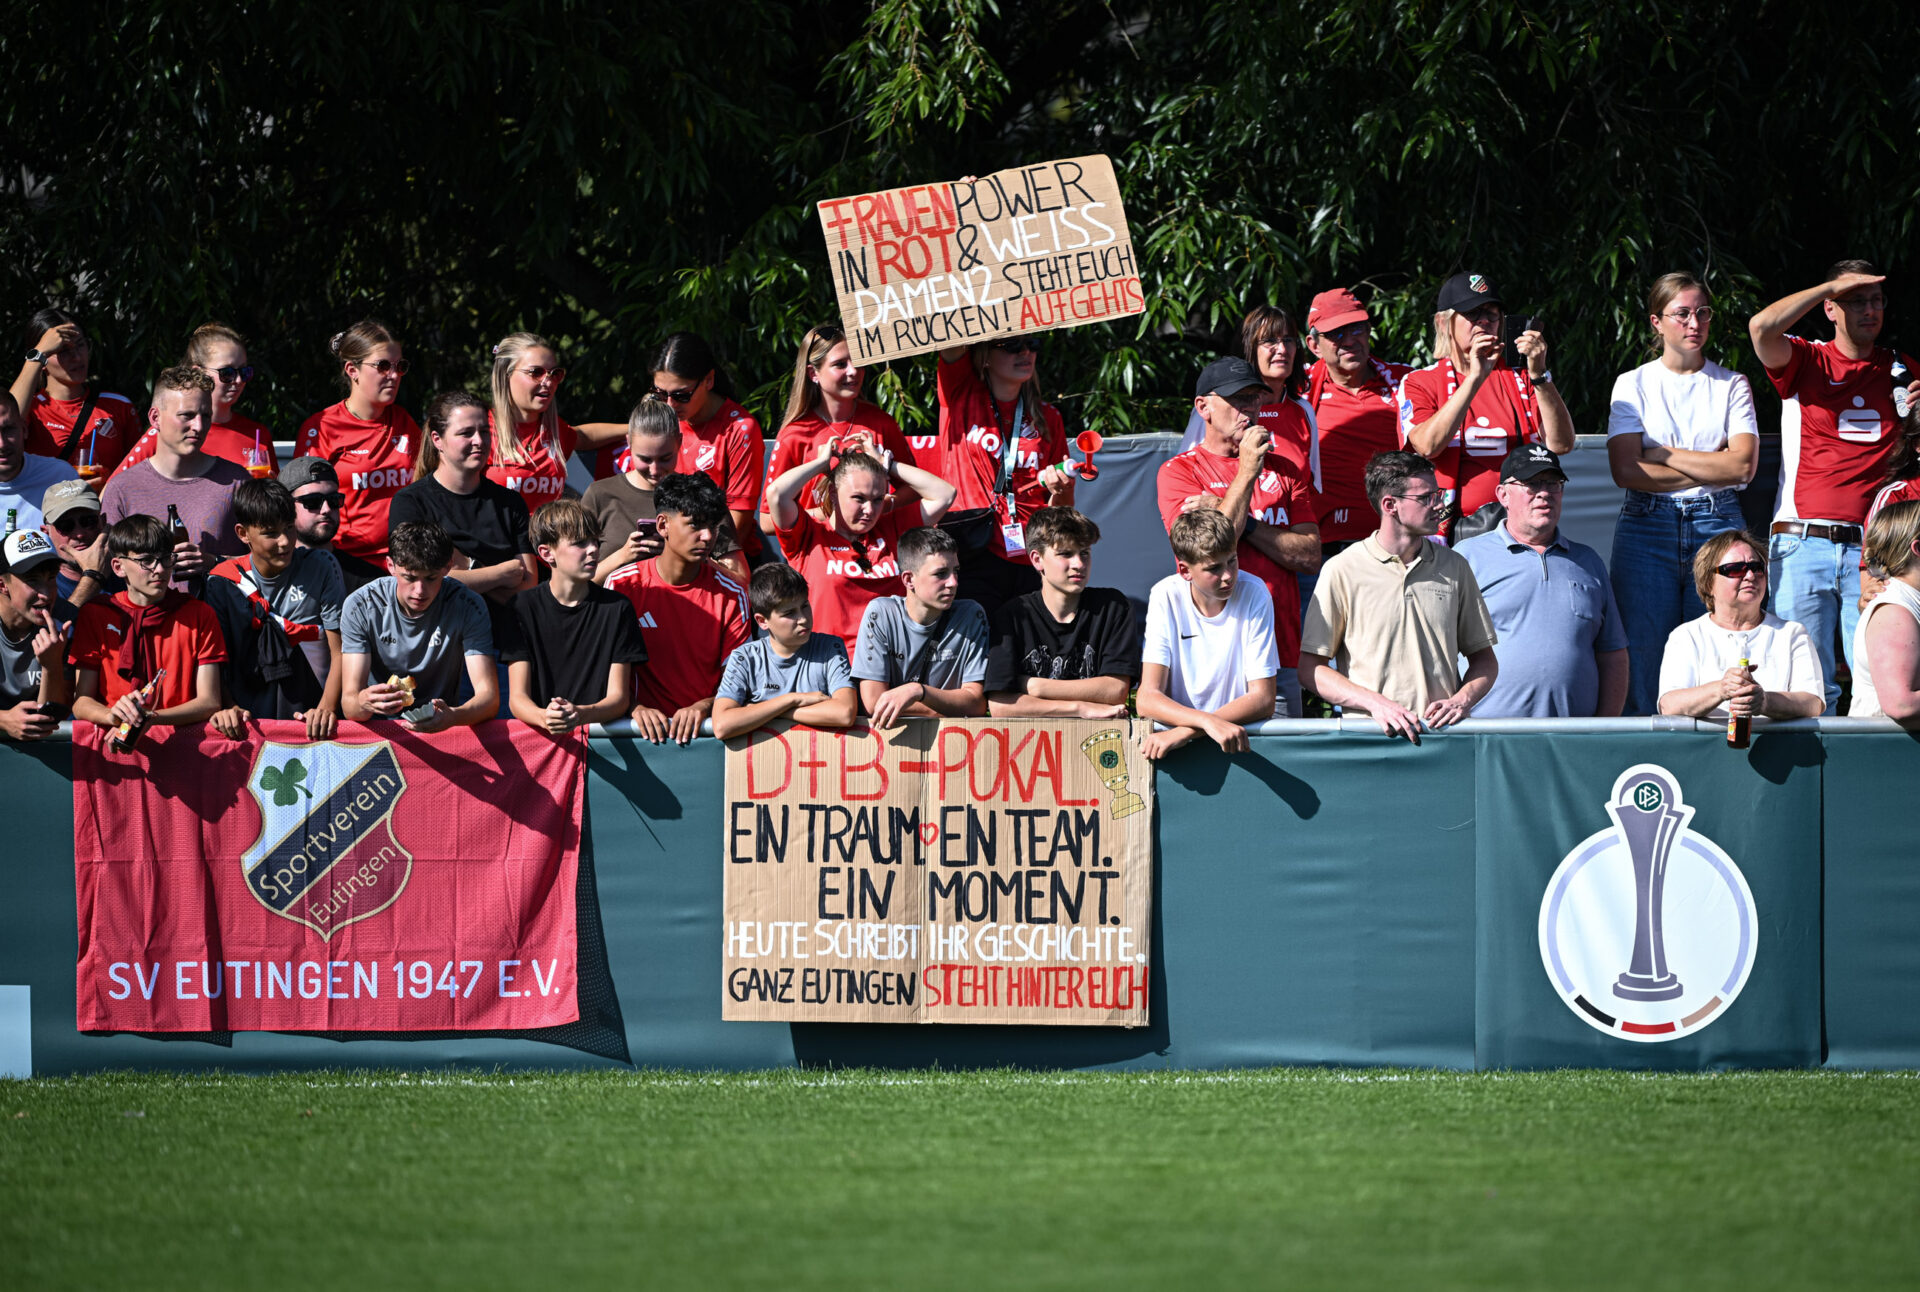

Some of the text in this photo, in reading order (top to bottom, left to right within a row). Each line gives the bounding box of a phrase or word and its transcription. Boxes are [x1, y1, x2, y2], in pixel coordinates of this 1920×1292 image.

[837, 202, 1116, 294] IN ROT & WEISS
[1002, 254, 1075, 302] STEHT
[1077, 244, 1135, 284] EUCH
[856, 326, 885, 359] IM
[1529, 456, 1552, 464] adidas
[1334, 508, 1349, 524] MJ
[763, 682, 780, 690] JAKO
[259, 772, 397, 902] Sportverein
[730, 802, 789, 864] EIN
[940, 803, 996, 867] EIN
[1004, 808, 1113, 867] TEAM.
[308, 844, 397, 925] Eutingen
[818, 866, 1121, 926] EIN MOMENT.
[728, 919, 1146, 963] HEUTE SCHREIBT IHR GESCHICHTE.
[108, 958, 560, 1001] SV EUTINGEN 1947 E.V.
[728, 967, 795, 1003] GANZ
[923, 963, 1004, 1007] STEHT
[1006, 966, 1084, 1009] HINTER
[1087, 965, 1149, 1011] EUCH
